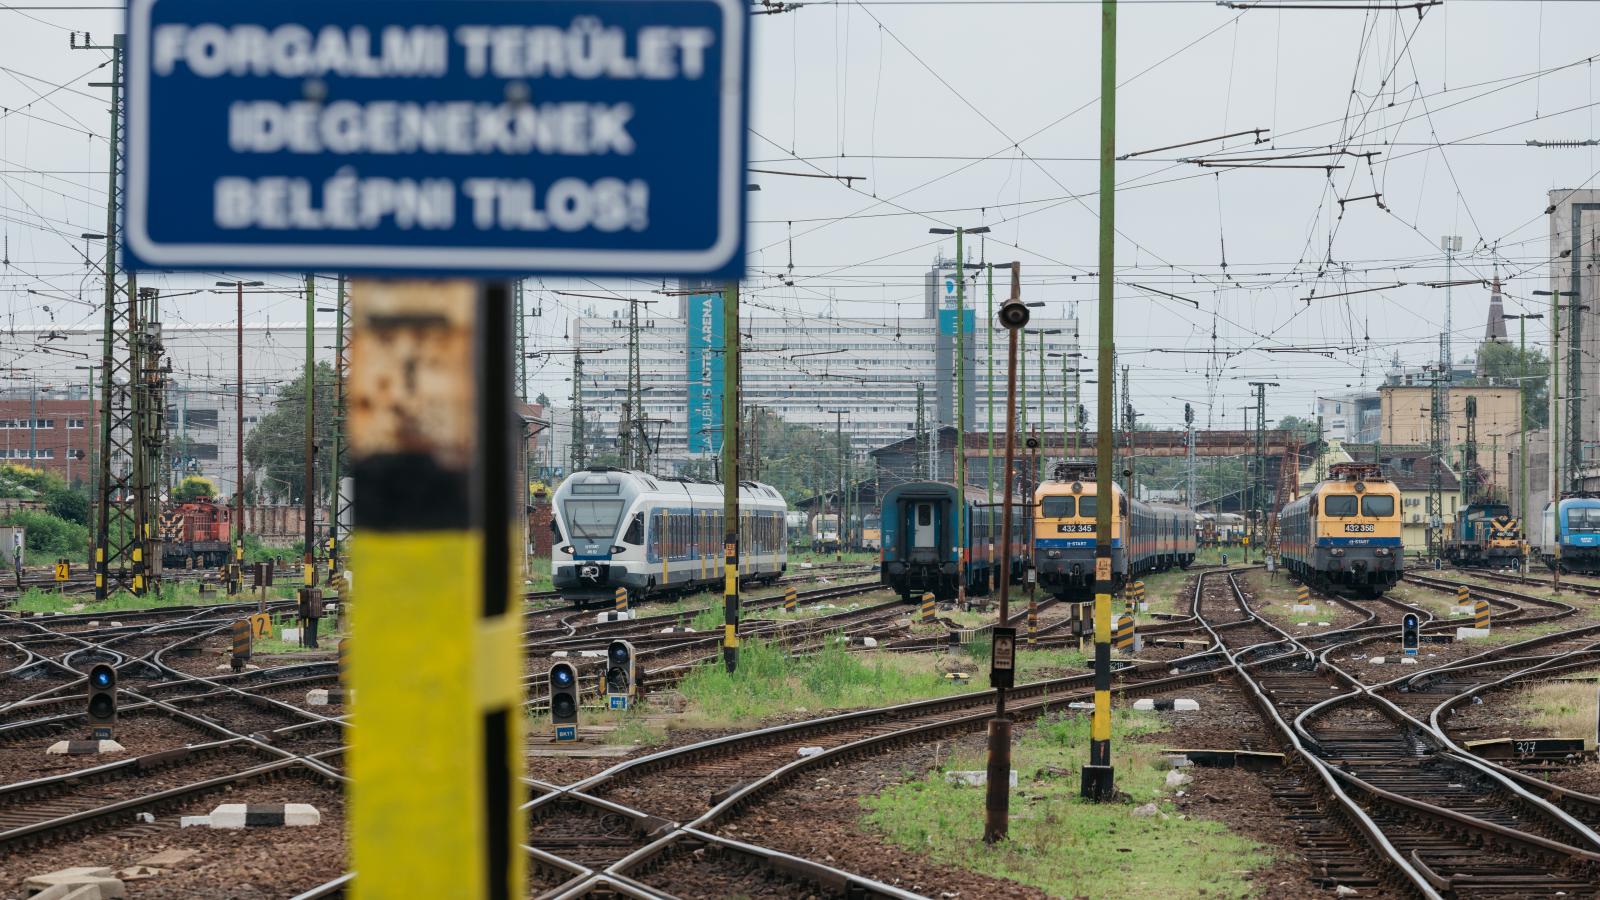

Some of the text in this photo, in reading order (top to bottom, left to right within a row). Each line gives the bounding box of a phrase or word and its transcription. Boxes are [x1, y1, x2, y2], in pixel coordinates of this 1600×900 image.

[153, 15, 714, 79] FORGALMI TERÜLET
[227, 99, 635, 155] IDEGENEKNEK
[213, 166, 649, 231] BELÉPNI TILOS!
[702, 298, 712, 343] ARENA
[702, 345, 712, 386] HOTEL
[1346, 524, 1360, 532] 432
[58, 564, 65, 578] 2
[256, 617, 268, 635] 2
